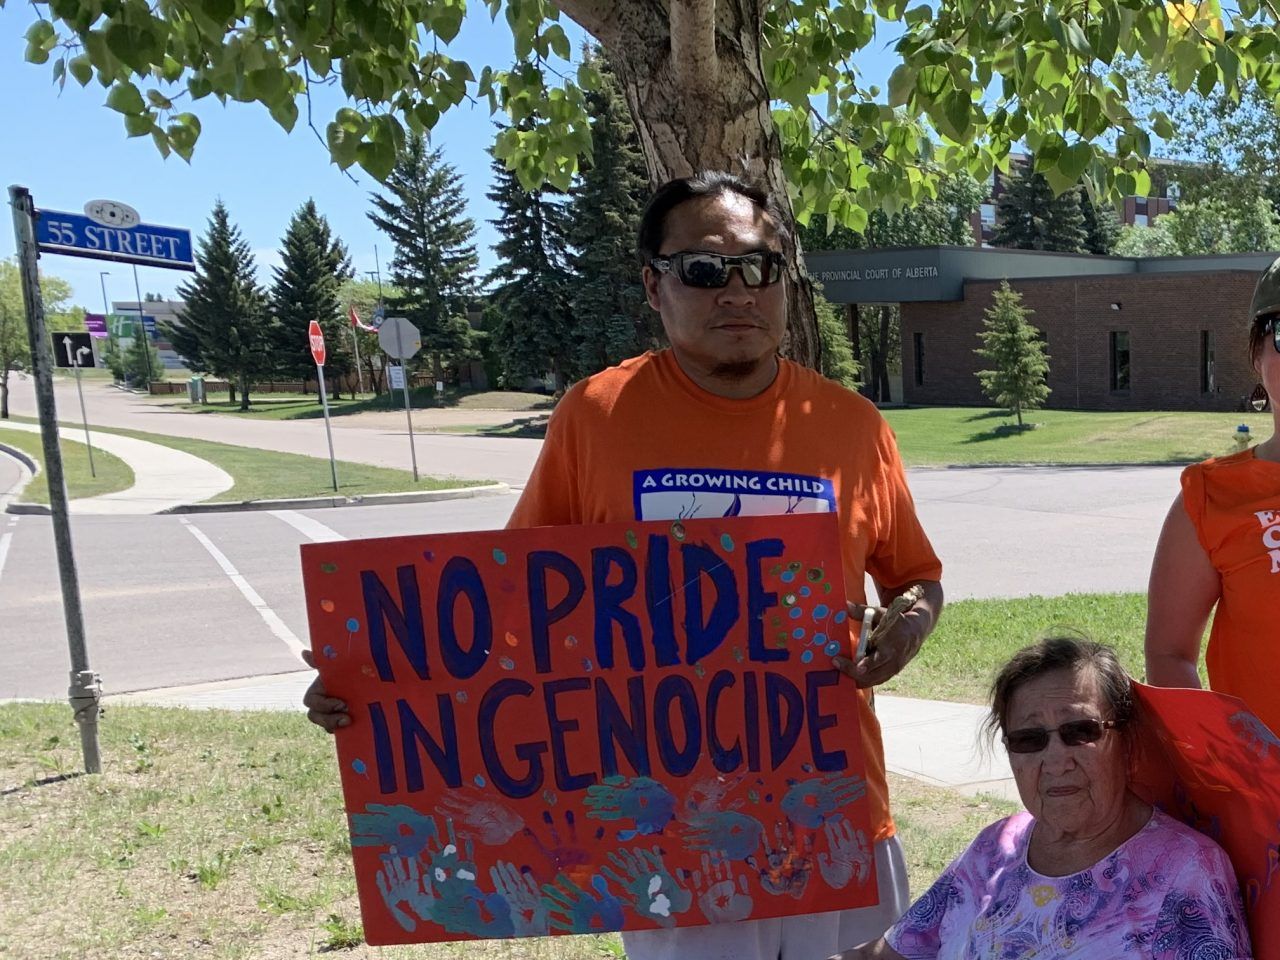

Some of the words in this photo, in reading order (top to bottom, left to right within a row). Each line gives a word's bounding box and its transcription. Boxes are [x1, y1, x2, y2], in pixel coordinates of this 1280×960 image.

[47, 220, 76, 246] 55
[84, 225, 181, 260] STREET
[821, 271, 861, 282] PROVINCIAL
[865, 268, 889, 280] COURT
[892, 268, 902, 279] OF
[905, 266, 939, 279] ALBERTA
[309, 334, 325, 352] STOP
[642, 475, 657, 488] A
[661, 472, 761, 491] GROWING
[766, 476, 825, 493] CHILD
[359, 555, 494, 683] NO
[526, 533, 792, 674] PRIDE
[367, 693, 463, 794] IN
[477, 669, 849, 799] GENOCIDE
